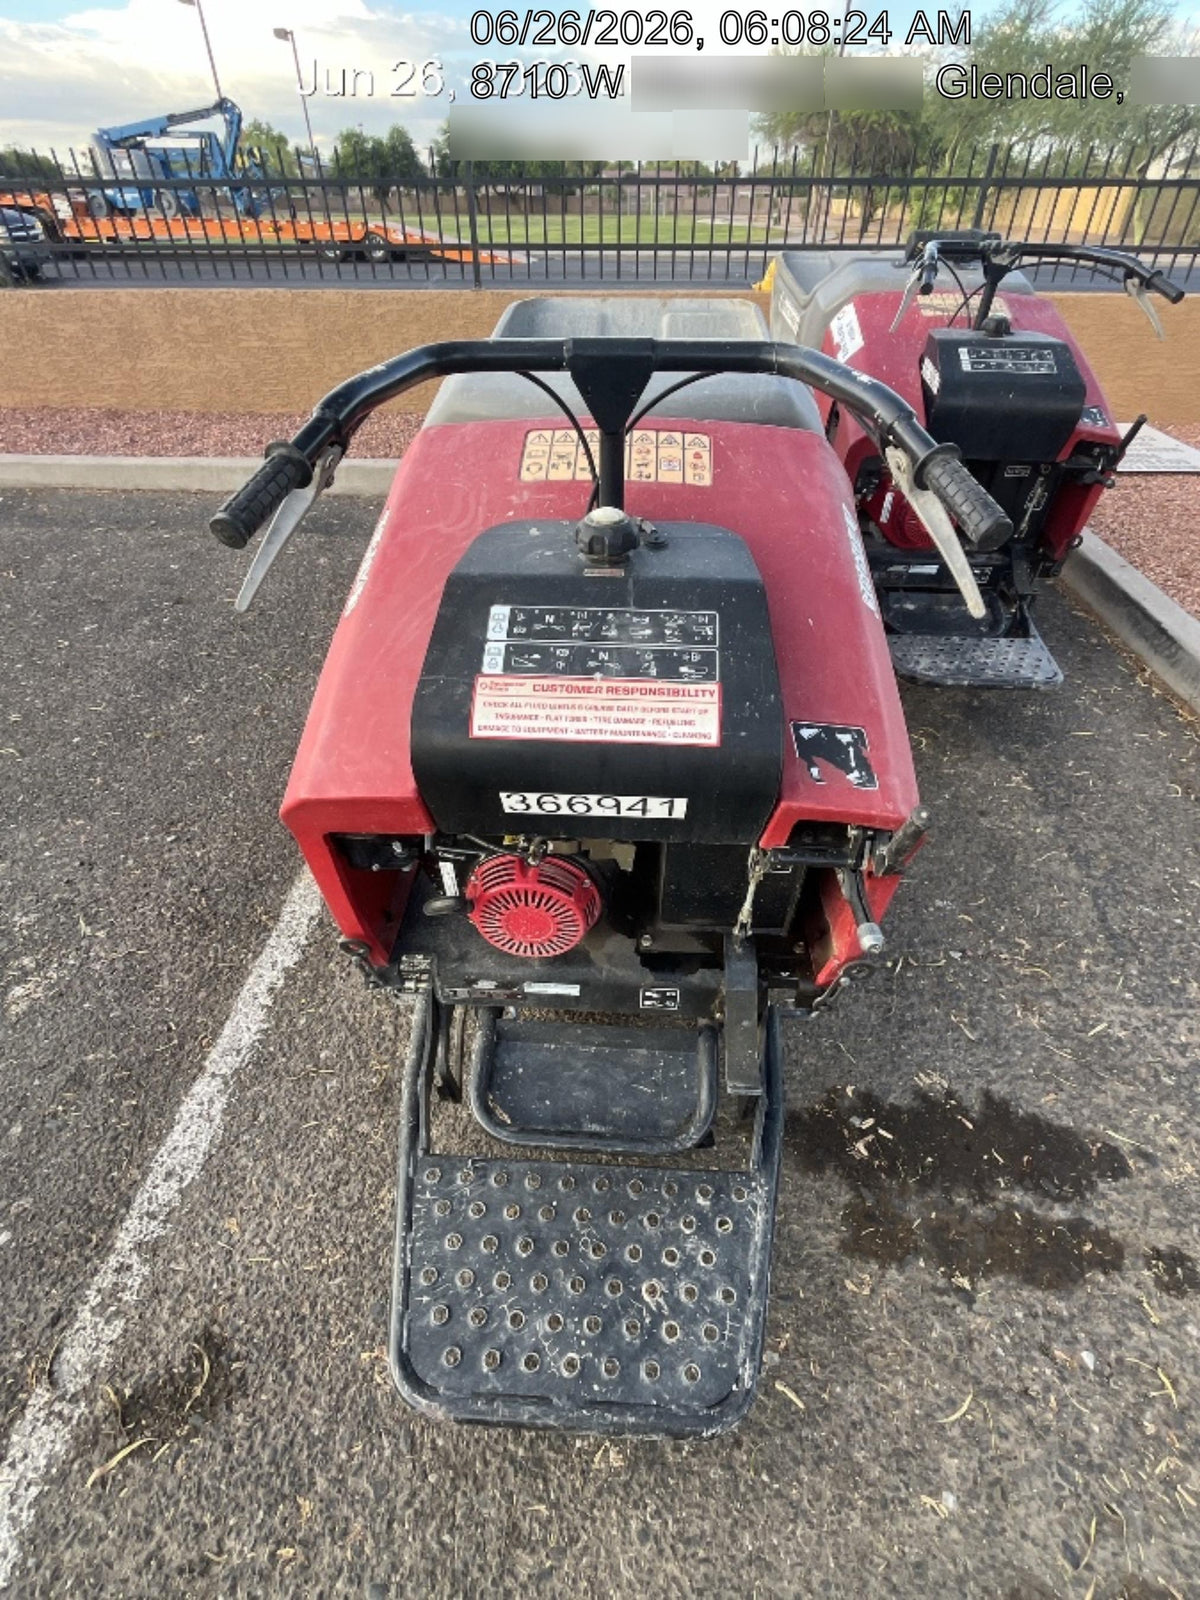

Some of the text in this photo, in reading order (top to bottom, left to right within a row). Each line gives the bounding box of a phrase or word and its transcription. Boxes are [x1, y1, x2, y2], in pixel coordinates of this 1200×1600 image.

[532, 683, 604, 695] CUSTOMER
[605, 685, 716, 698] RESPONSIBILITY
[505, 793, 676, 817] 366941
